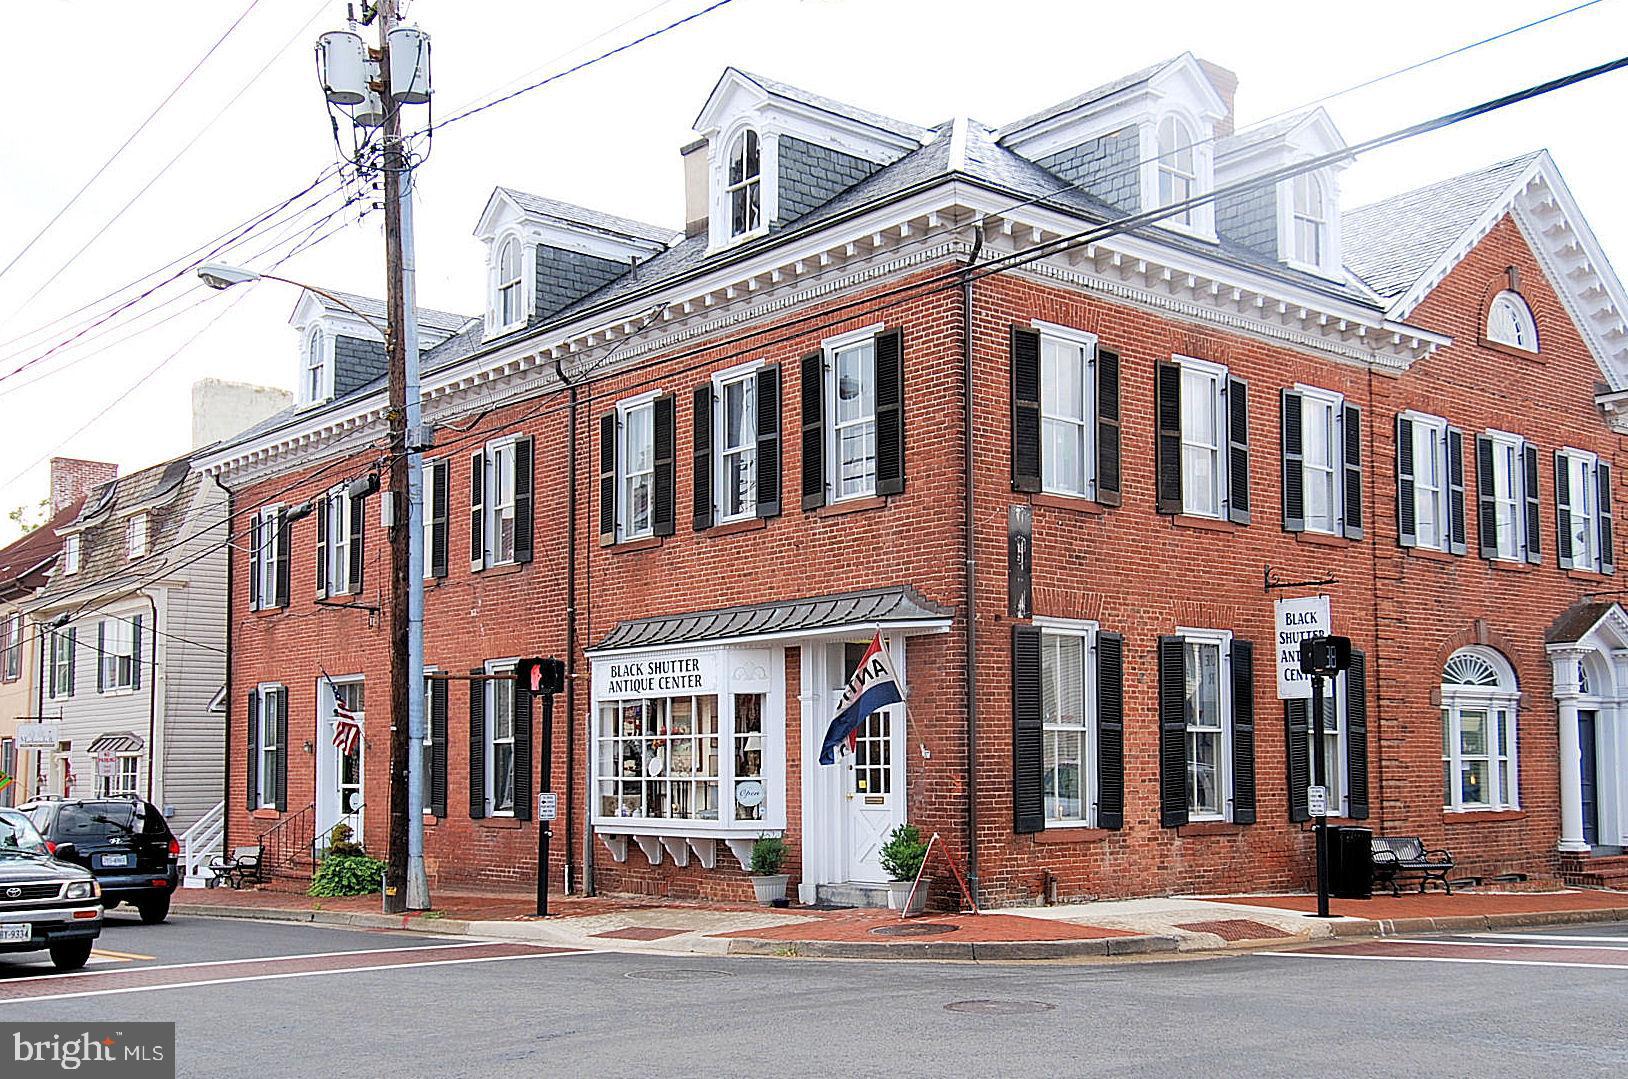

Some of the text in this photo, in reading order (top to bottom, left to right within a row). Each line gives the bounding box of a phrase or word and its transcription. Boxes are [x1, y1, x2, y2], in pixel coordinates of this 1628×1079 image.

[1285, 611, 1318, 626] BLACK
[610, 658, 700, 679] BLACK SHUTTER
[608, 674, 702, 694] ANTIQUE CENTER
[739, 789, 760, 799] Open
